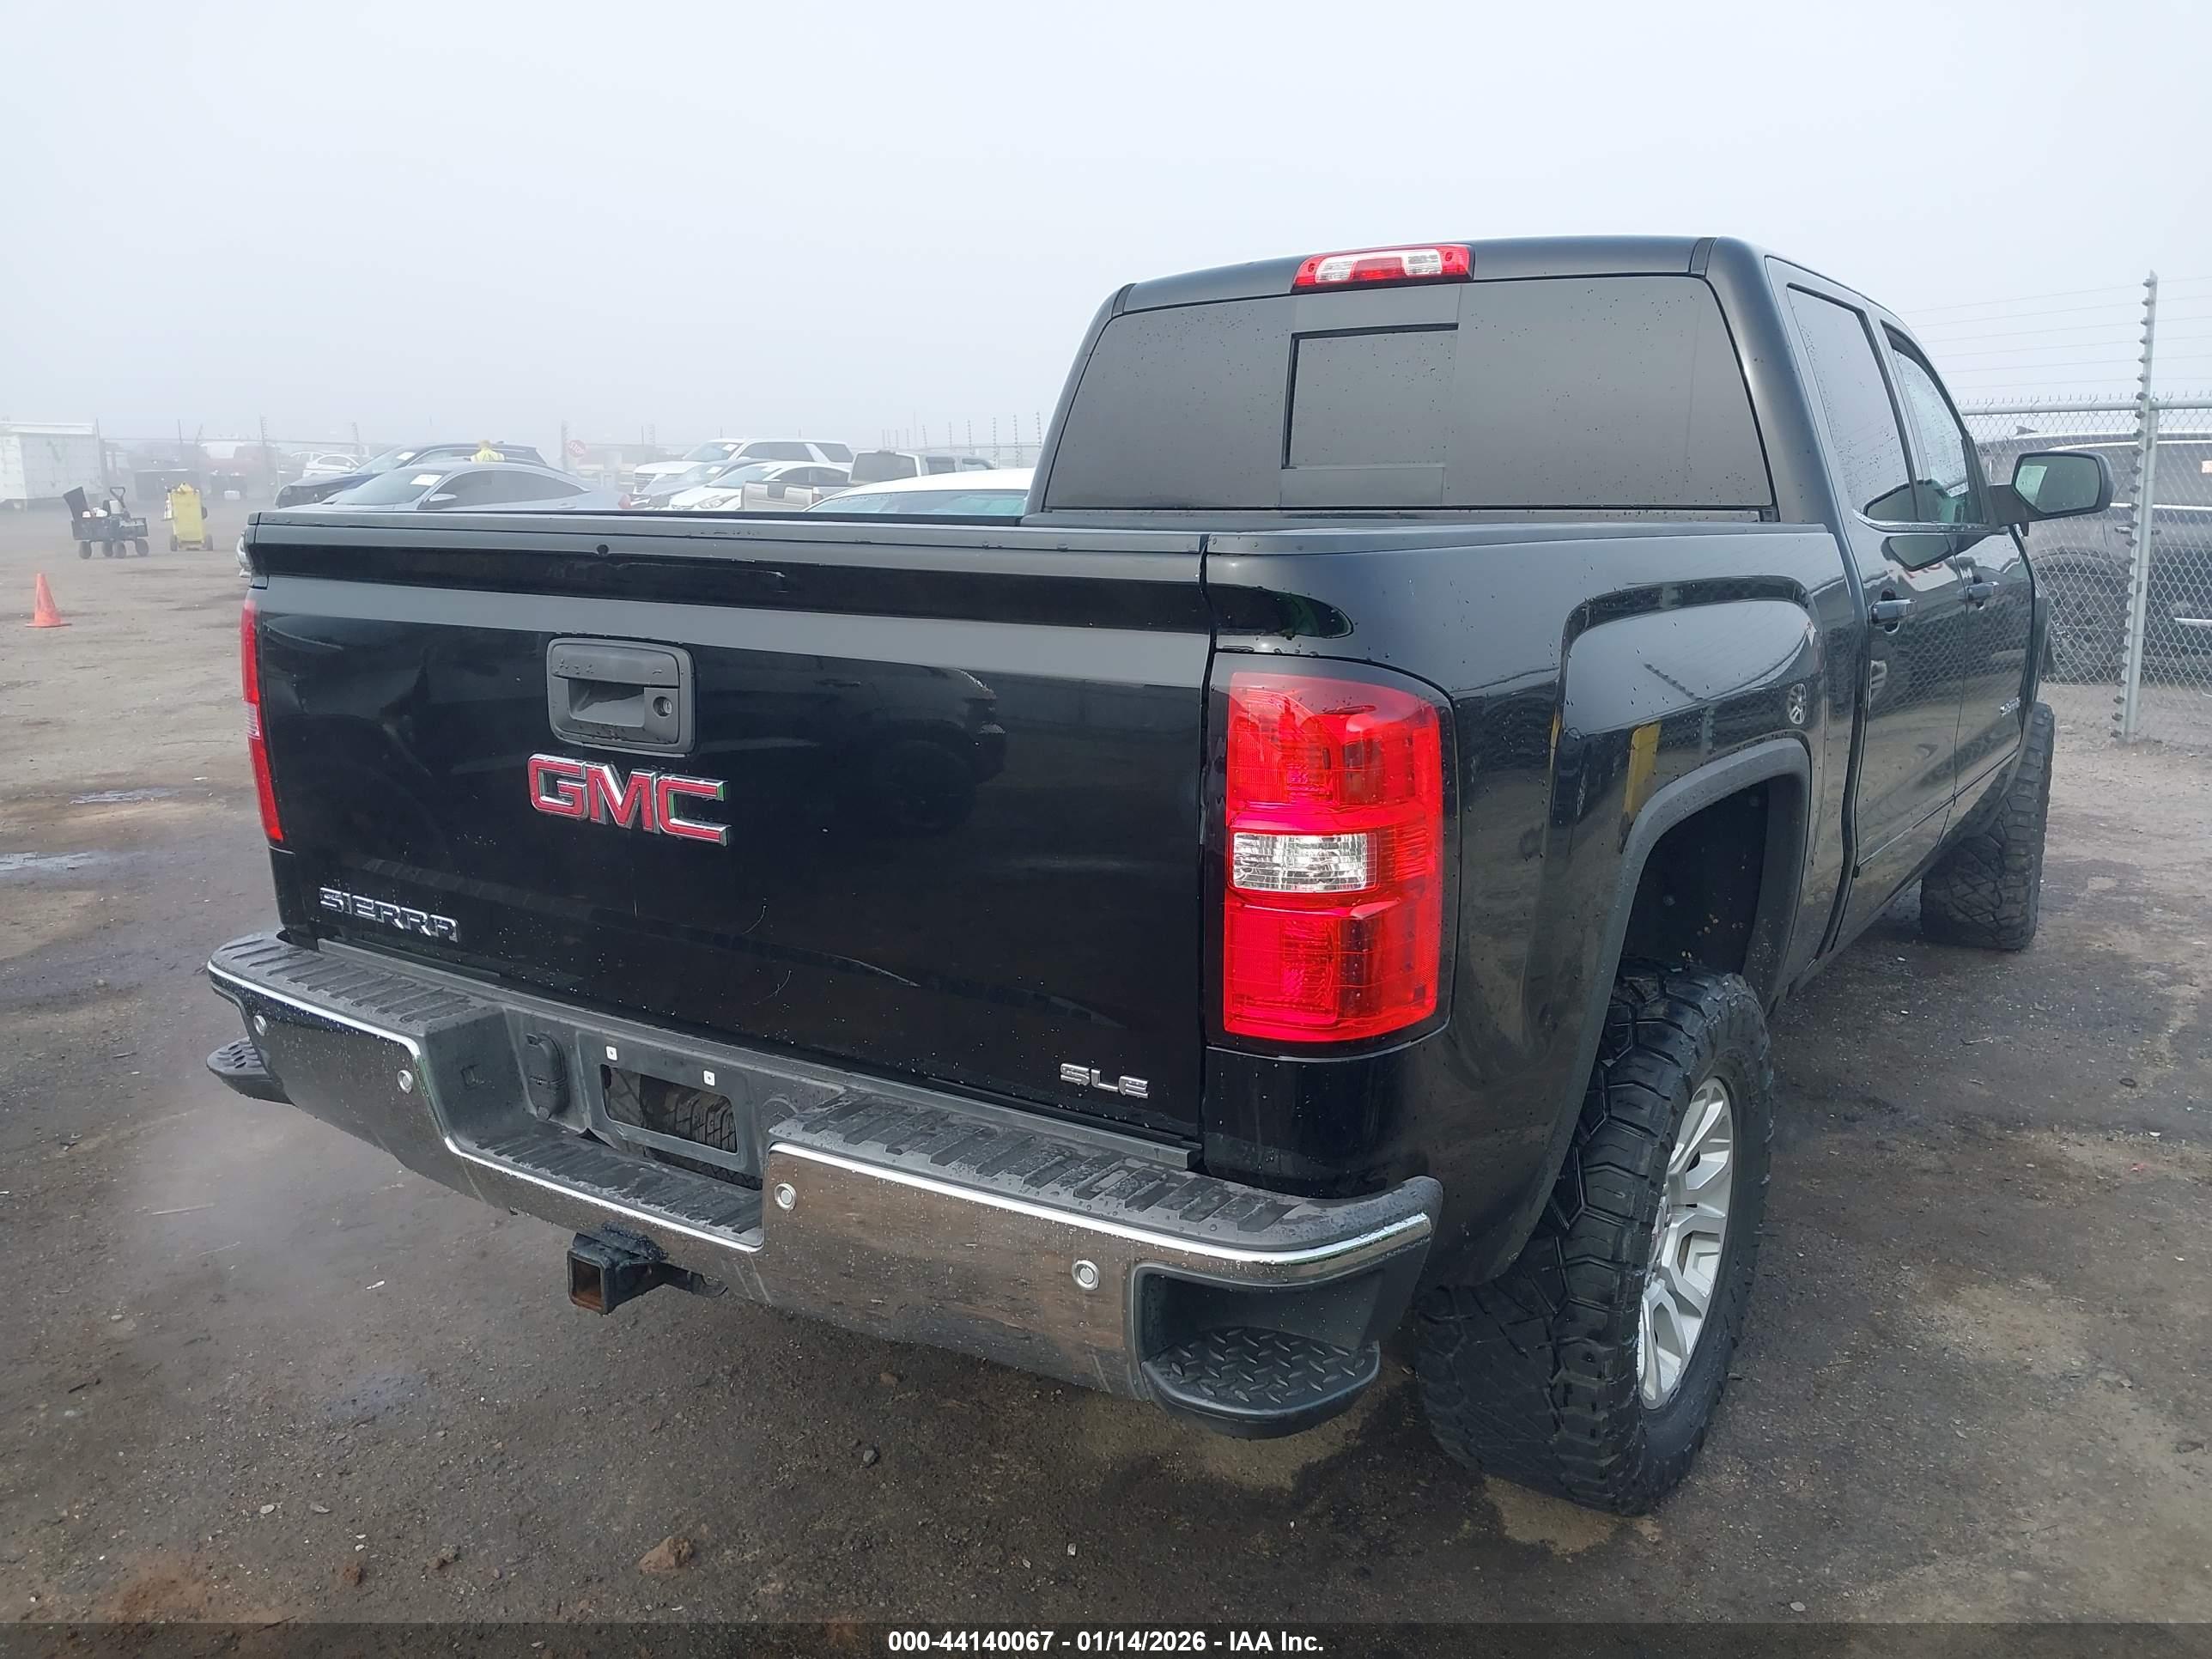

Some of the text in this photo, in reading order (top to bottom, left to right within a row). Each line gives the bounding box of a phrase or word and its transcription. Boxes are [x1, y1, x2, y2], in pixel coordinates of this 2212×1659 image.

[527, 753, 732, 847] GMC
[319, 887, 460, 943] SIERRA
[1060, 1063, 1150, 1099] SLE
